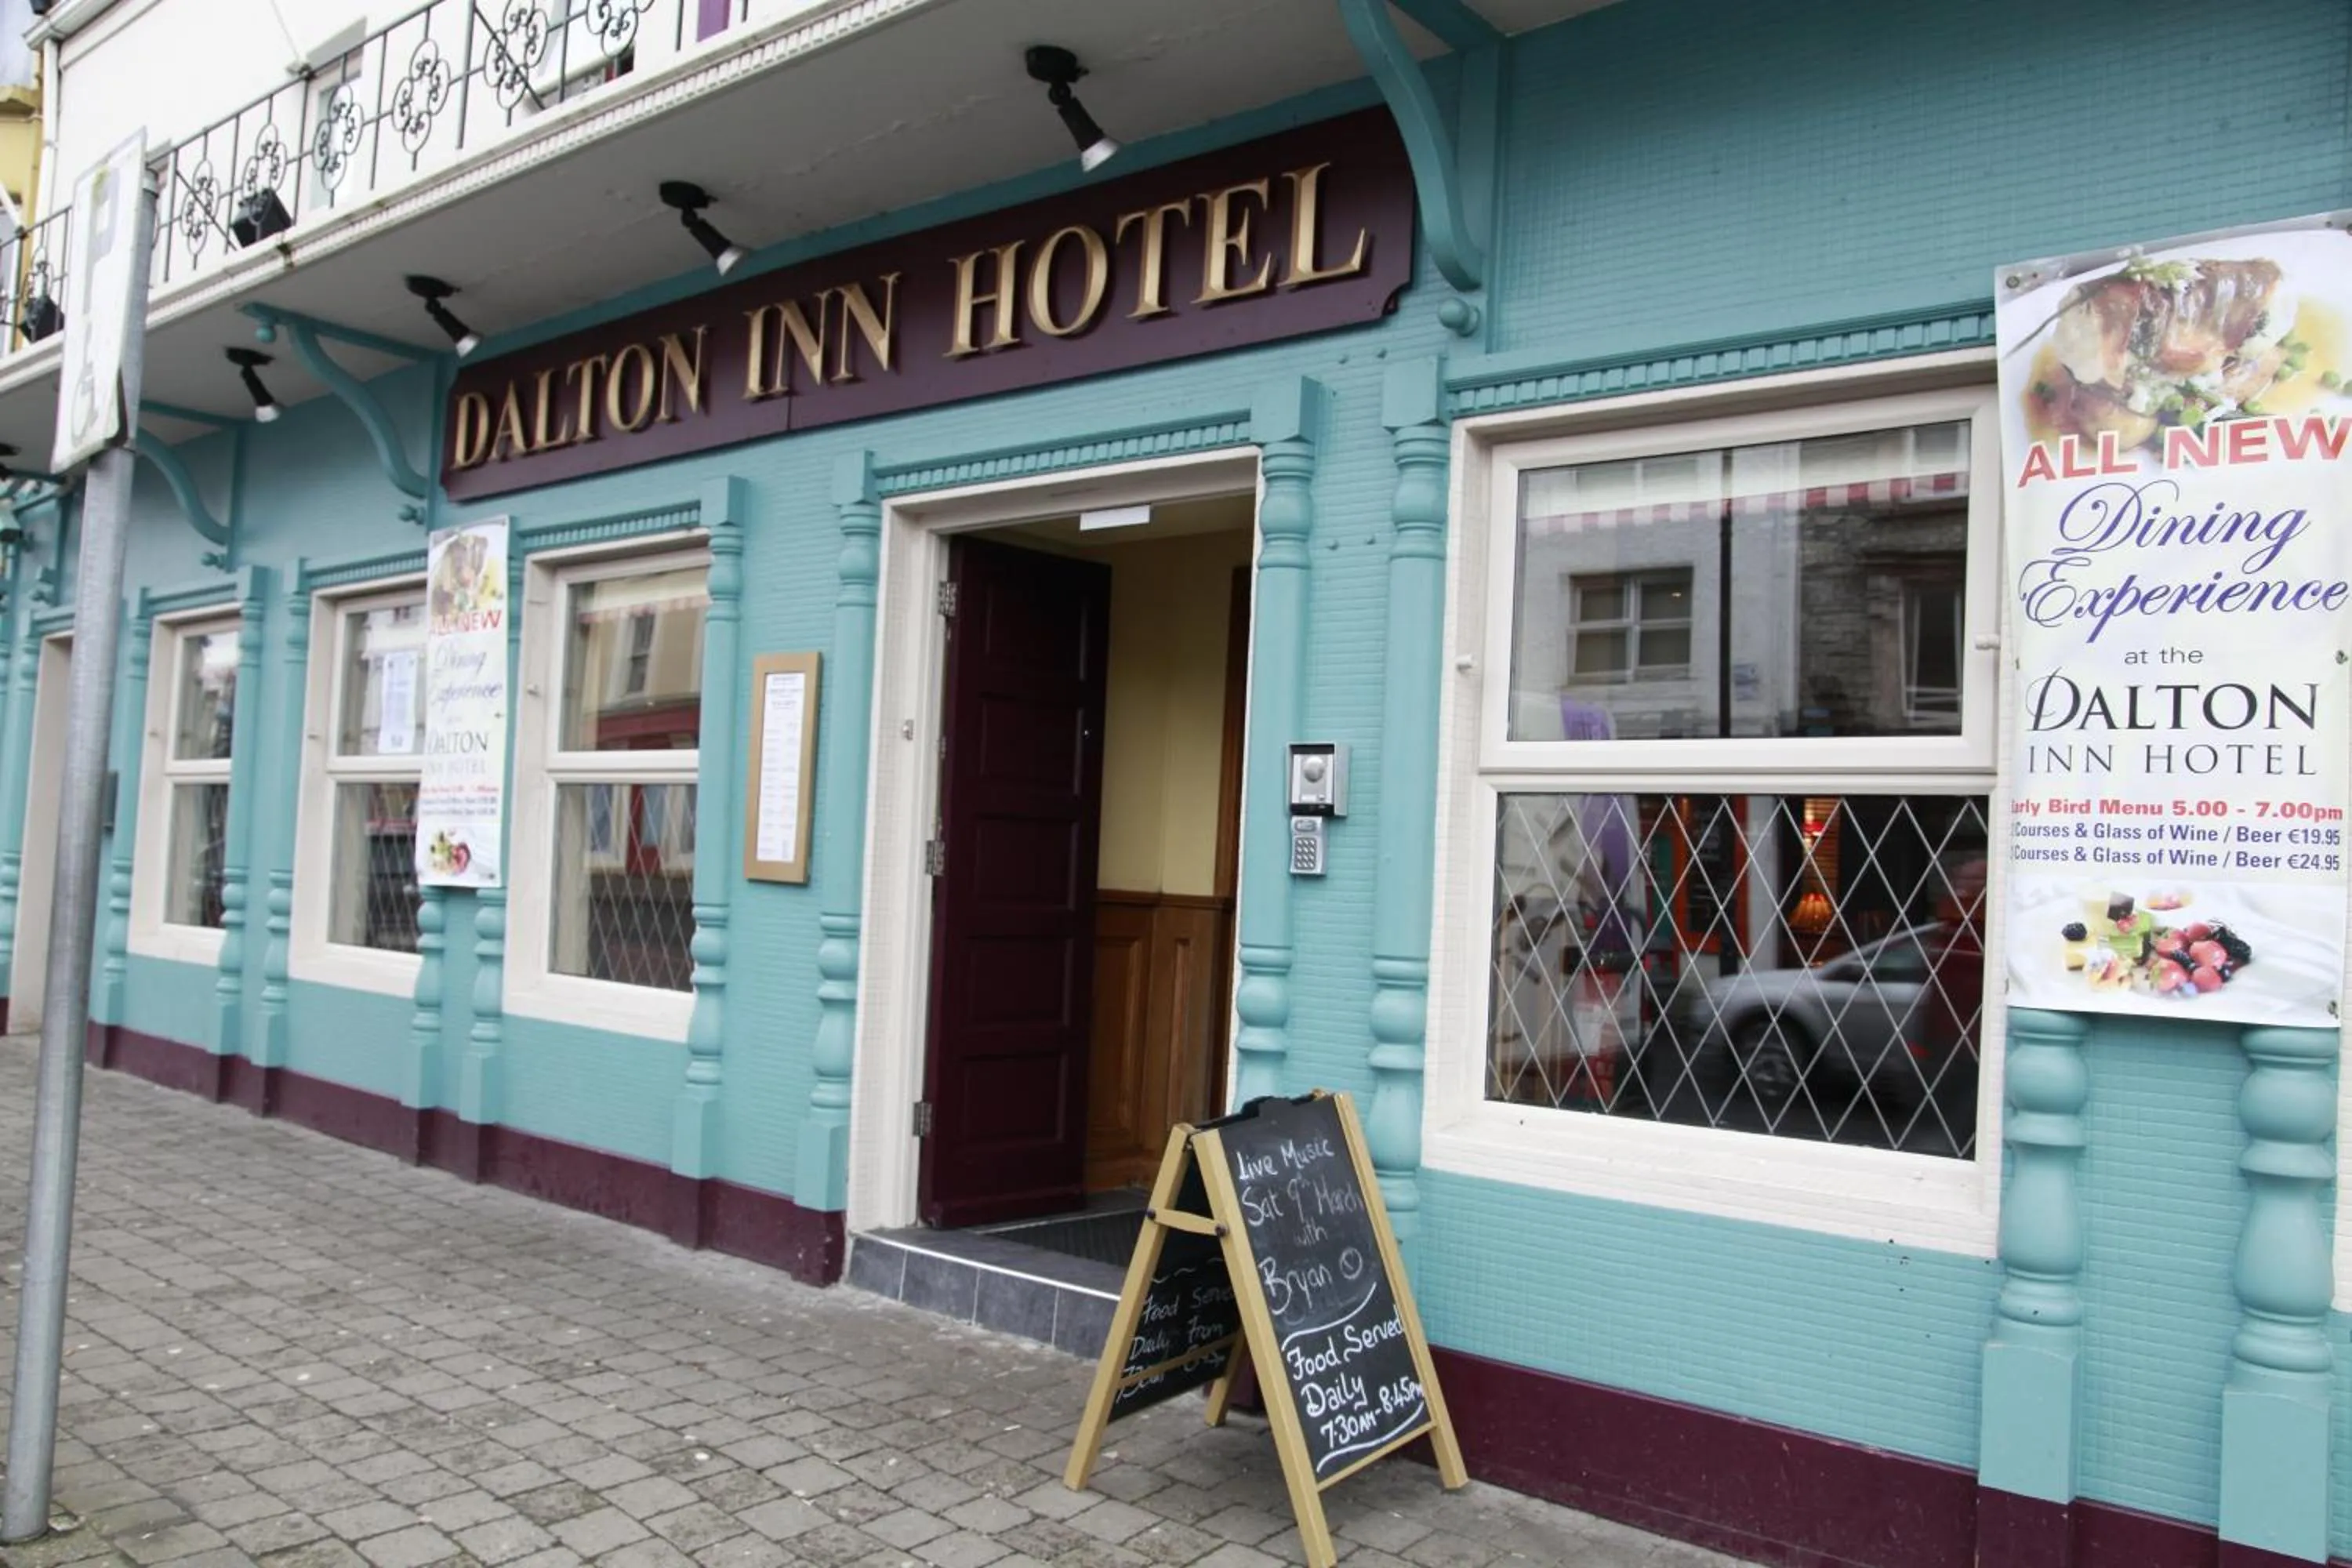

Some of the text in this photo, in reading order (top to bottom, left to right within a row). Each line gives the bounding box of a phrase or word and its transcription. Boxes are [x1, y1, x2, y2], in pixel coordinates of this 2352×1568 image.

[450, 162, 1366, 470] DALTON INN HOTEL
[2018, 416, 2352, 488] ALL NEW
[2052, 479, 2311, 574] Dining
[2018, 557, 2350, 643] Experience
[2124, 647, 2205, 665] at the
[2025, 666, 2321, 731] DALTON
[2029, 744, 2318, 775] INN HOTEL
[2049, 798, 2092, 815] Bird
[2100, 799, 2163, 816] Menu
[2172, 800, 2228, 817] 5.00
[2256, 801, 2343, 822] 7.00pm
[2074, 822, 2088, 838] &
[2094, 822, 2142, 840] Glass
[2147, 824, 2165, 840] of
[2170, 824, 2219, 842] Wine
[2223, 826, 2231, 844] /
[2237, 826, 2282, 844] Beer
[2288, 828, 2340, 846] €19.95
[2014, 844, 2070, 861] Courses
[2074, 845, 2087, 862] &
[2093, 846, 2142, 863] Glass
[2147, 848, 2165, 864] of
[2169, 848, 2218, 866] Wine
[2223, 851, 2231, 869] /
[2236, 851, 2281, 869] Beer
[2288, 853, 2340, 871] €24.95
[1236, 1138, 1334, 1181] Live Music
[1241, 1185, 1283, 1227] Sat
[1258, 1256, 1333, 1316] Bryan
[1142, 1294, 1179, 1326] Food
[1287, 1335, 1342, 1381] Food
[1344, 1304, 1405, 1363] Served
[1301, 1371, 1368, 1418] Daily
